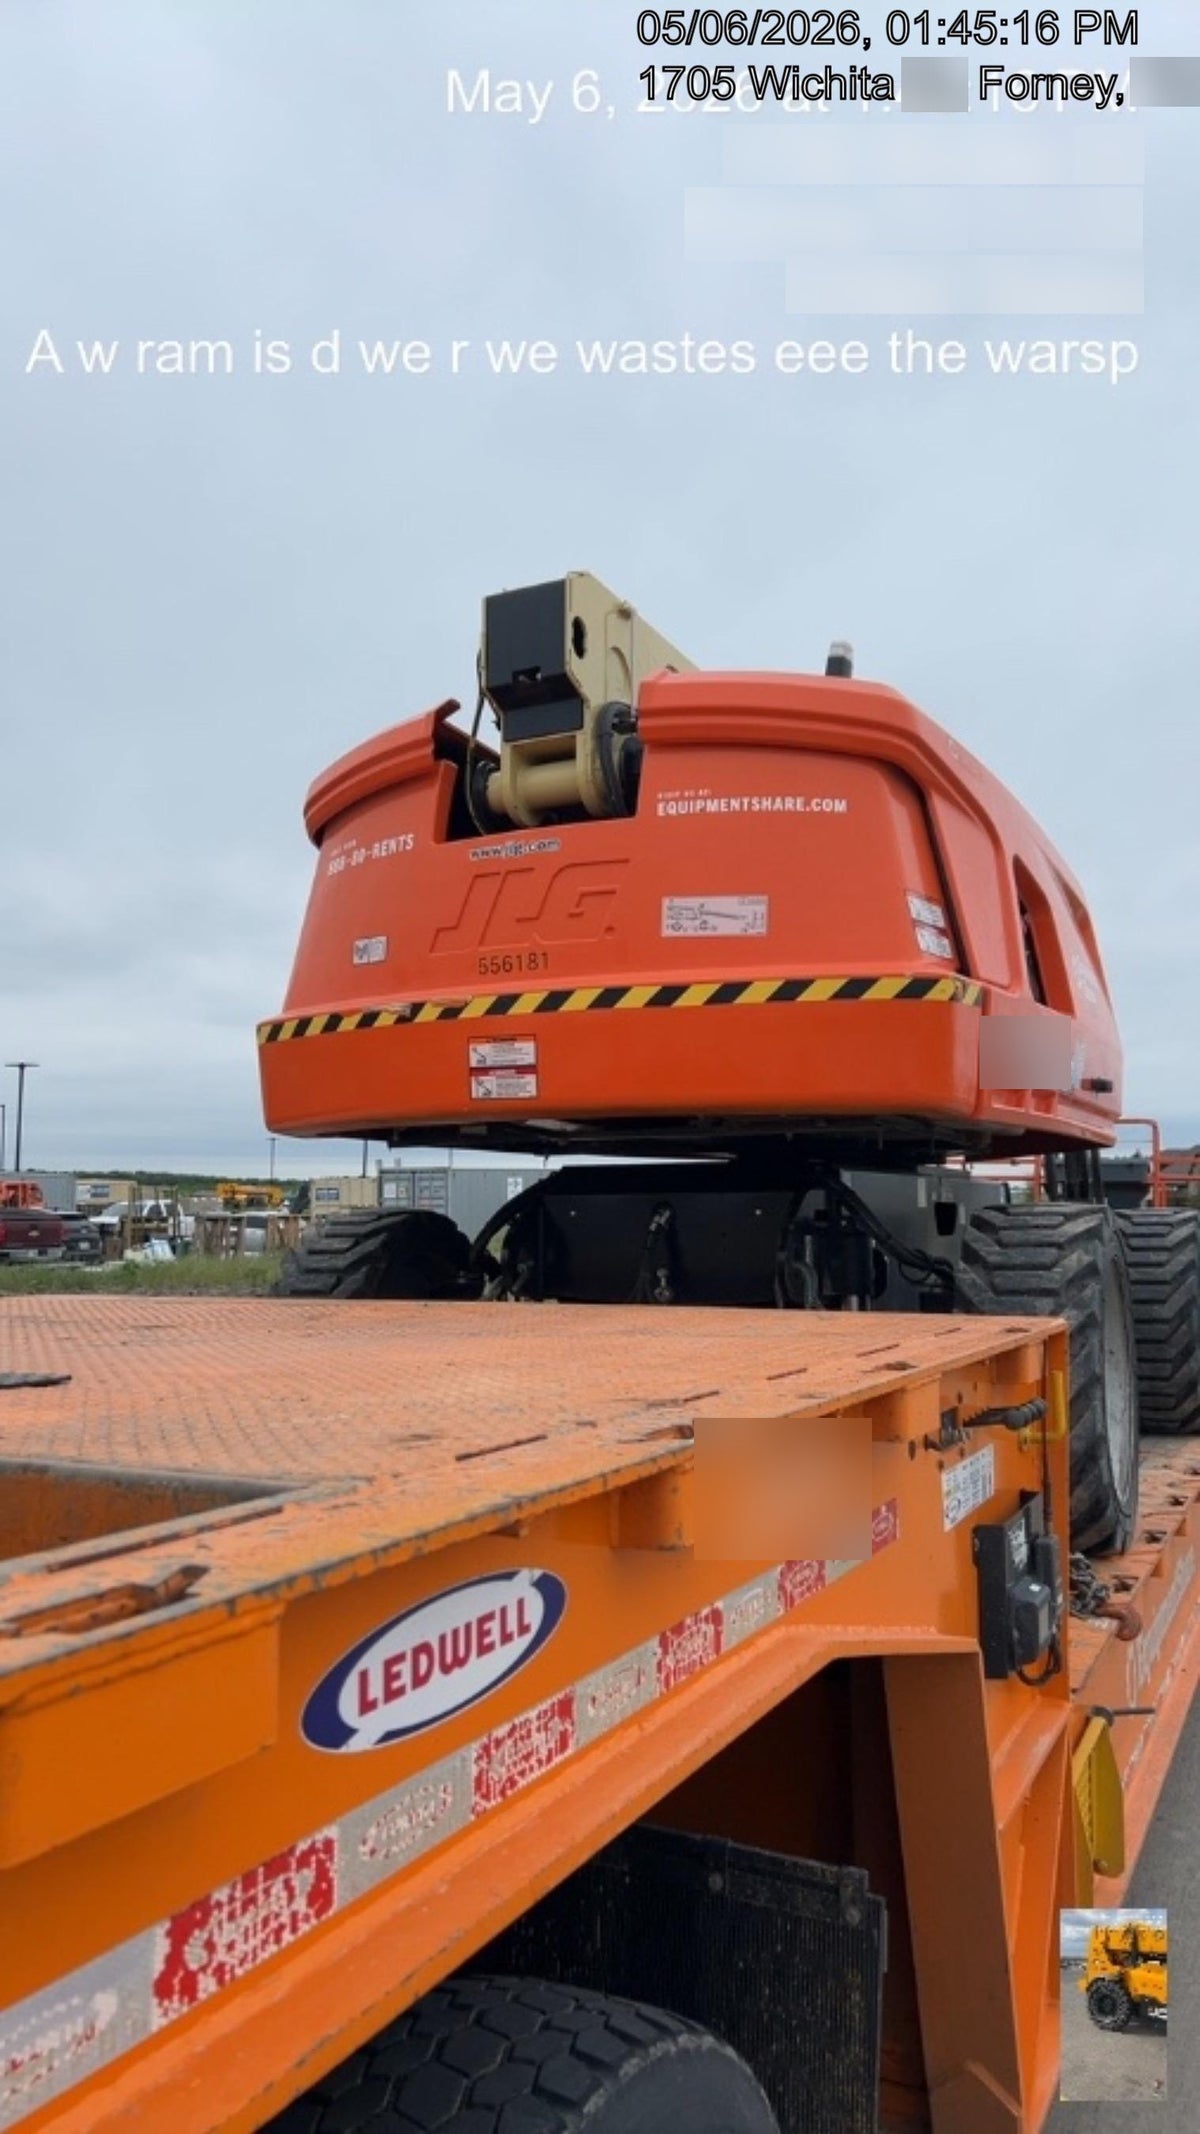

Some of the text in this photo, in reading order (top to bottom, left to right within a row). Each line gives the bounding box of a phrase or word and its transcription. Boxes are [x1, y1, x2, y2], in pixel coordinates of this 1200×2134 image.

[656, 797, 848, 817] EQUIPMENTSHARE.COM
[478, 951, 549, 976] 556181
[357, 1597, 532, 1718] LEDWELL
